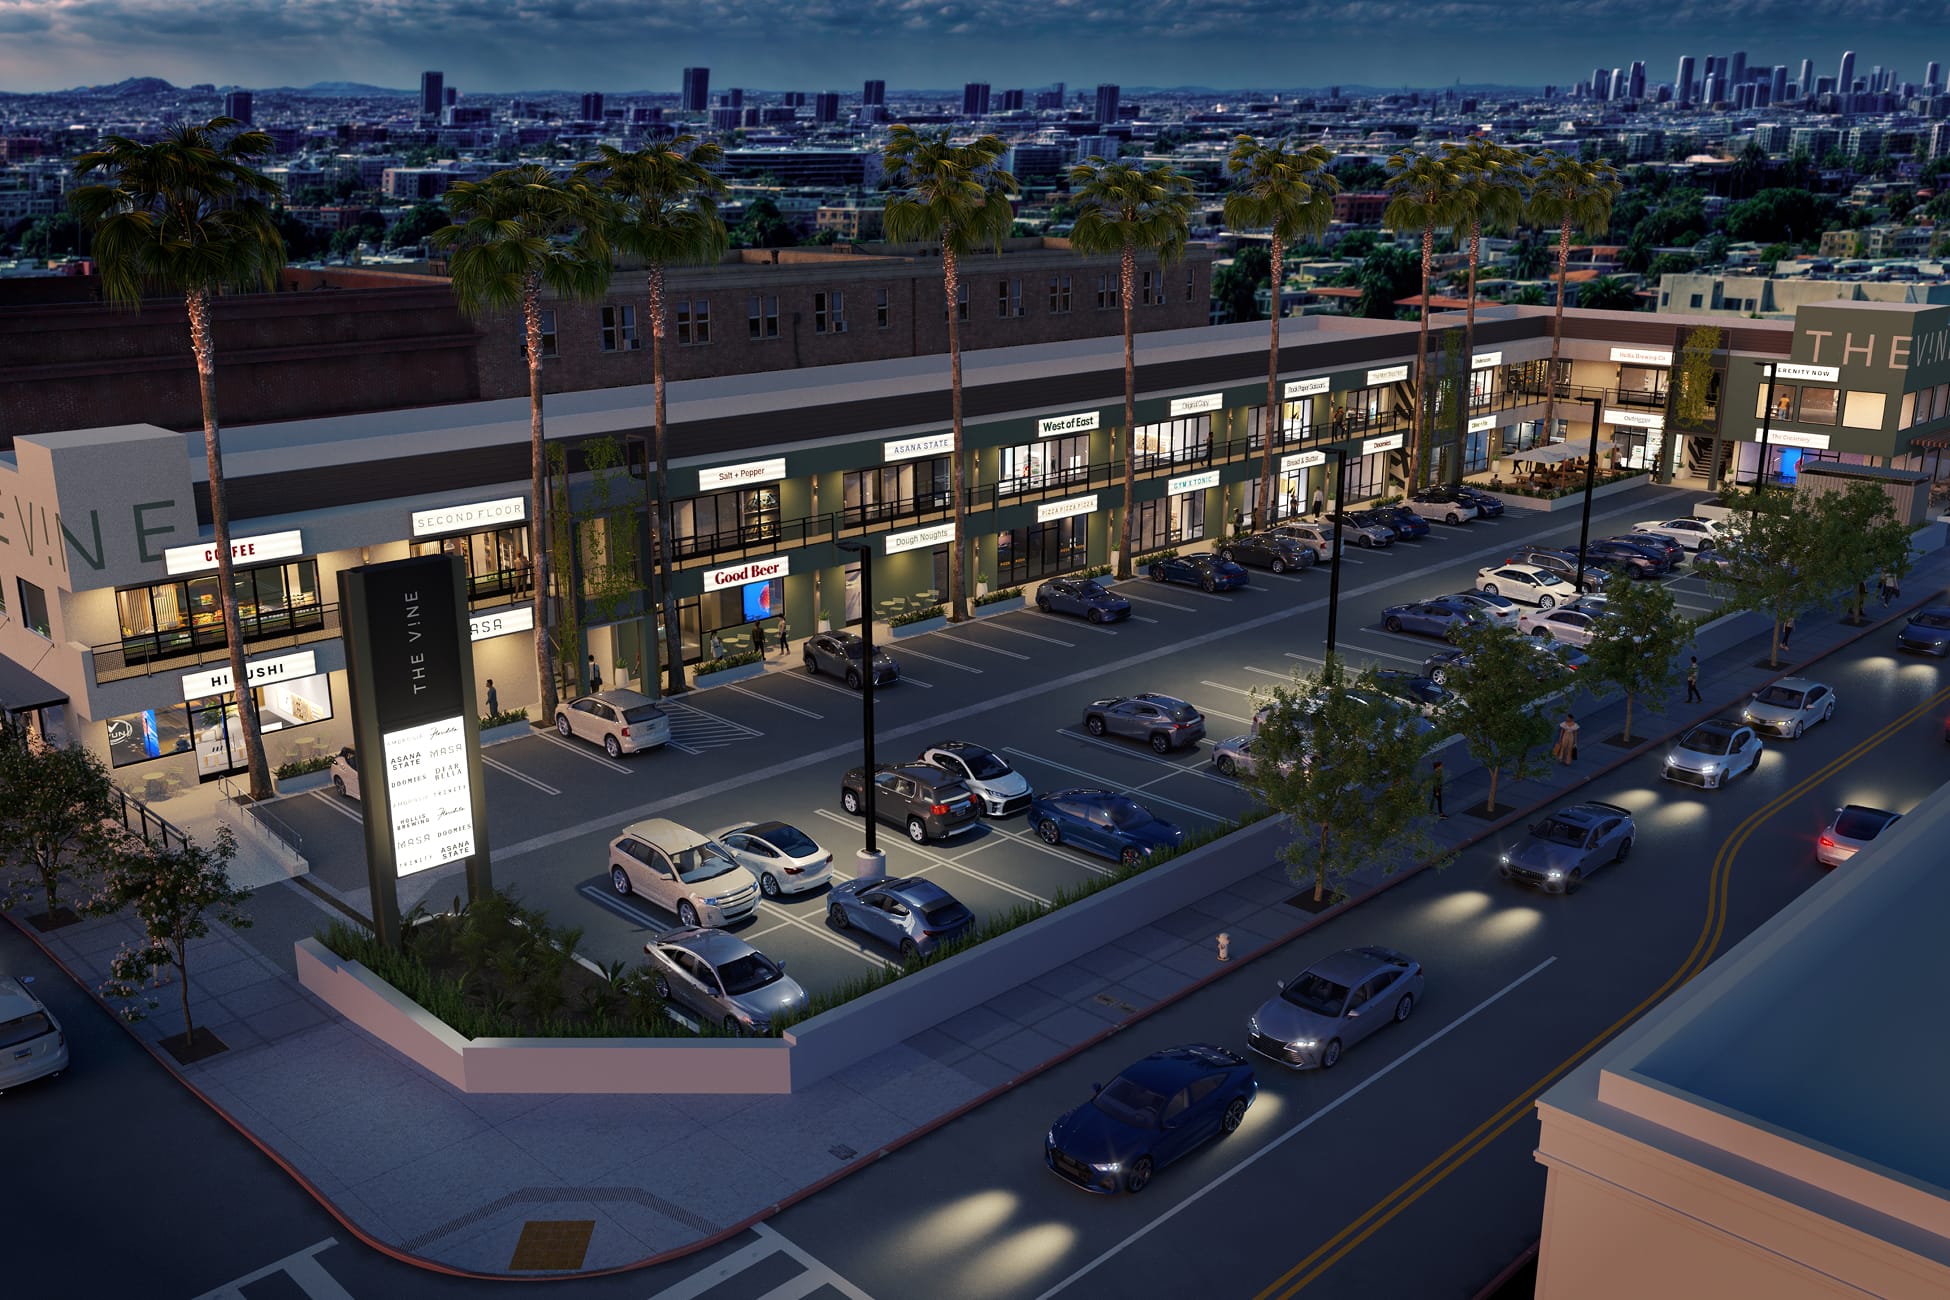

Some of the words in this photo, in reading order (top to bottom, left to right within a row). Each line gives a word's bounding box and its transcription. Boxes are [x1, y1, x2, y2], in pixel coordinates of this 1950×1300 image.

[1805, 330, 1913, 370] THE
[1777, 367, 1810, 375] ERENITY
[1811, 369, 1830, 377] NOW
[1042, 420, 1065, 432] West
[1066, 417, 1076, 429] of
[1076, 416, 1094, 427] East
[894, 443, 922, 454] ASANA
[923, 439, 948, 450] STATE
[718, 471, 733, 481] Salt
[740, 467, 765, 478] Pepper
[417, 511, 473, 528] SECOND
[478, 504, 521, 519] FLOOR
[895, 534, 919, 546] Dough
[205, 543, 256, 562] COFEE
[714, 566, 748, 585] Good
[751, 564, 780, 578] Beer
[470, 618, 502, 636] ASA
[244, 663, 284, 680] USHI
[410, 652, 427, 694] THE
[390, 751, 421, 765] ASANA
[392, 758, 421, 771] STATE
[440, 840, 470, 853] ASANA
[442, 846, 470, 860] STATE
